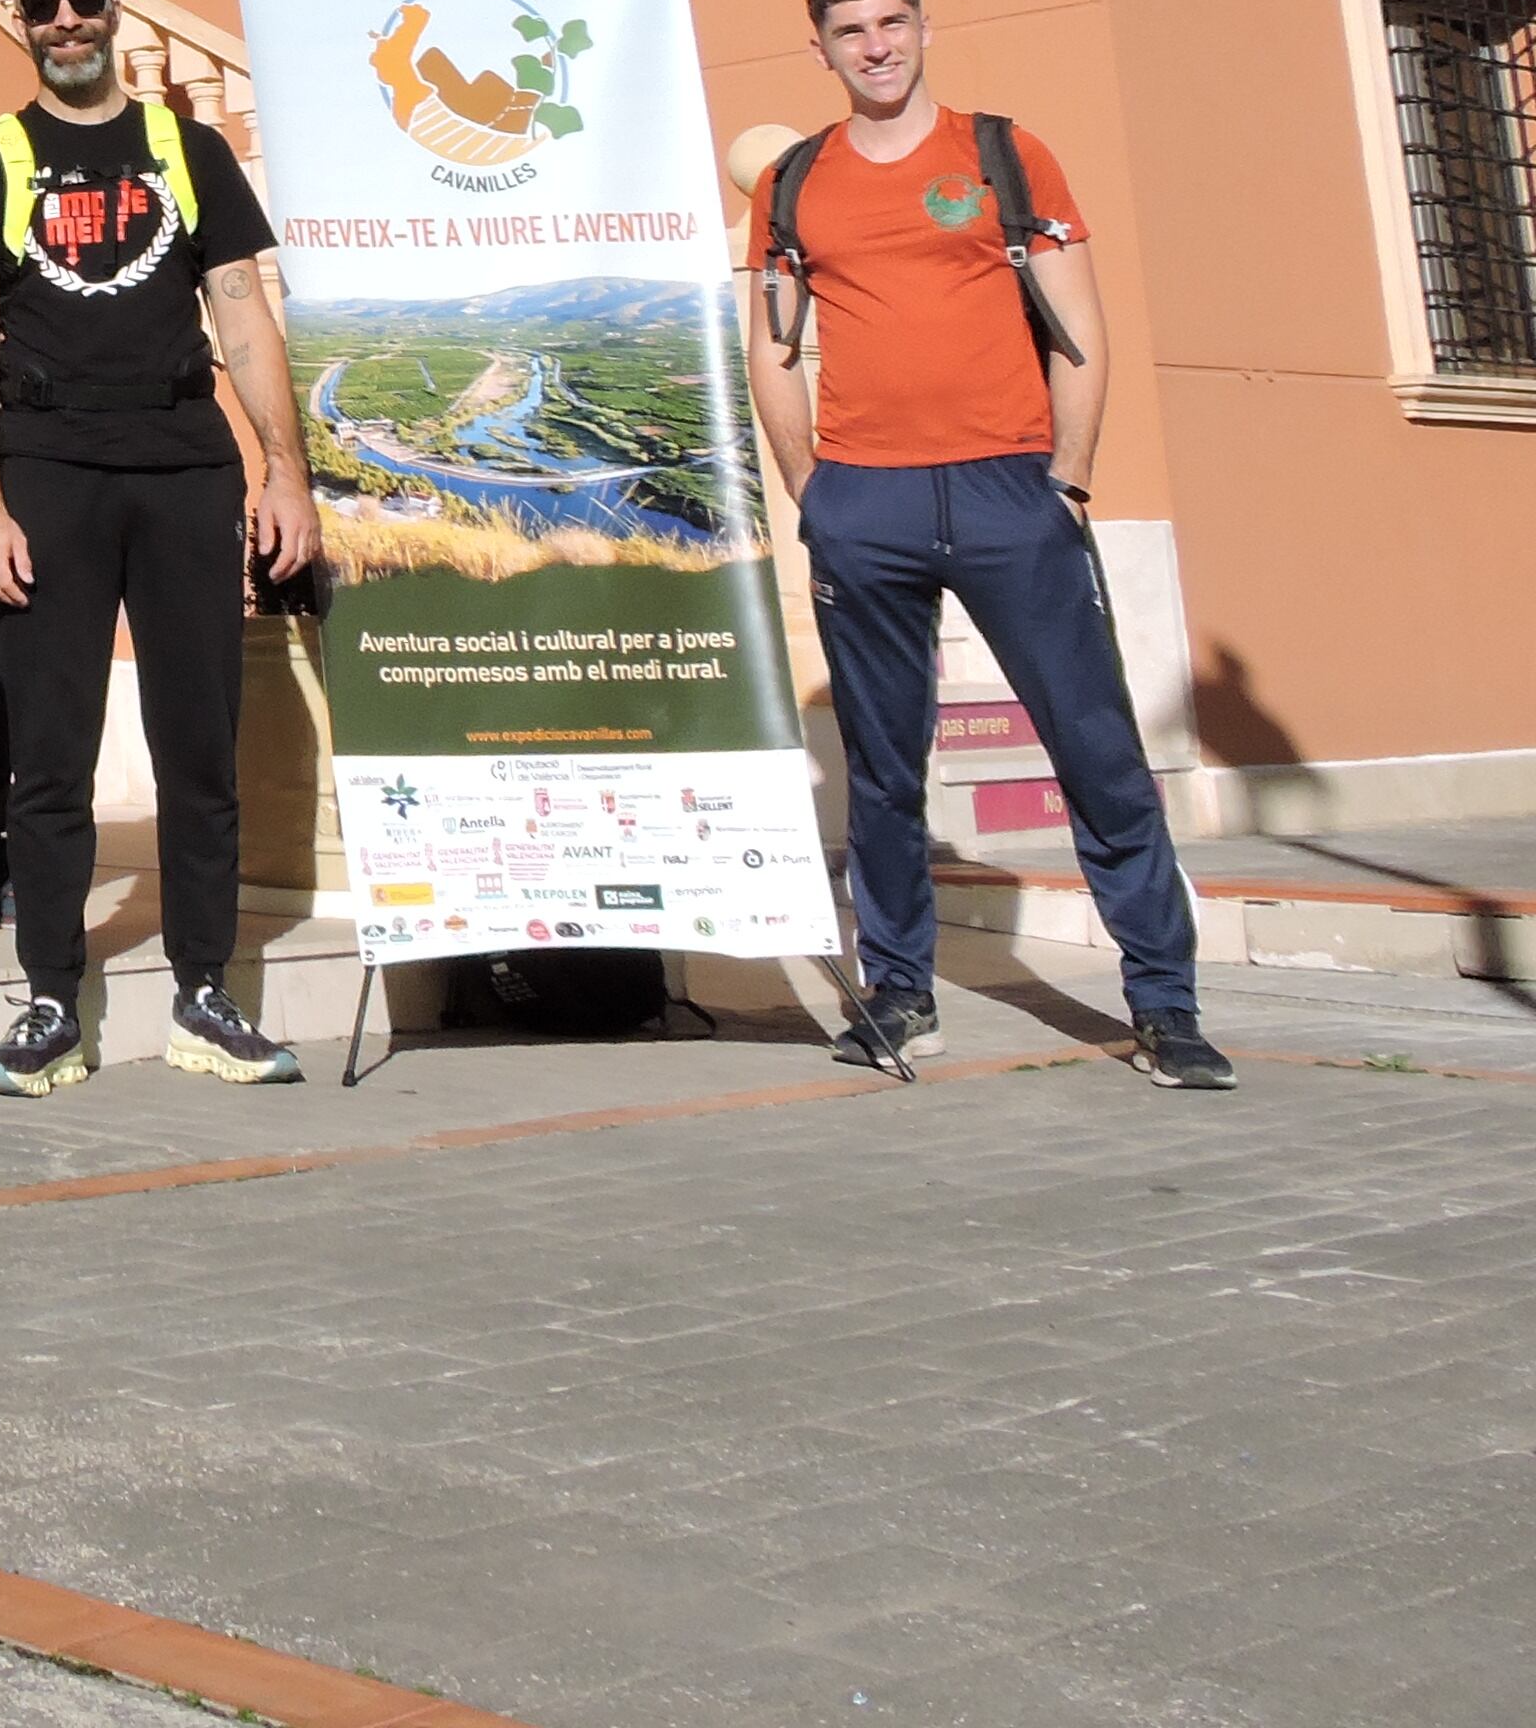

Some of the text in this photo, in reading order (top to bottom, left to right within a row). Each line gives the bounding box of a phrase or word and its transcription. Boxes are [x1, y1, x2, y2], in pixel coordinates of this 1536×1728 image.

[430, 163, 537, 193] CAVANILLES
[284, 212, 699, 248] ATREVEIX-TE A VIURE L'AVENTURA
[359, 628, 737, 655] Aventura social i cultural per a joves
[379, 658, 728, 688] compromesos amb el medi rural.
[941, 715, 1011, 743] pas enrere
[696, 802, 734, 812] SELLENT
[459, 816, 506, 830] Antella
[438, 846, 489, 856] GENERALITAT
[505, 843, 556, 852] GENERALITAT
[562, 846, 613, 859] AVANT
[534, 888, 588, 899] REPOLEN
